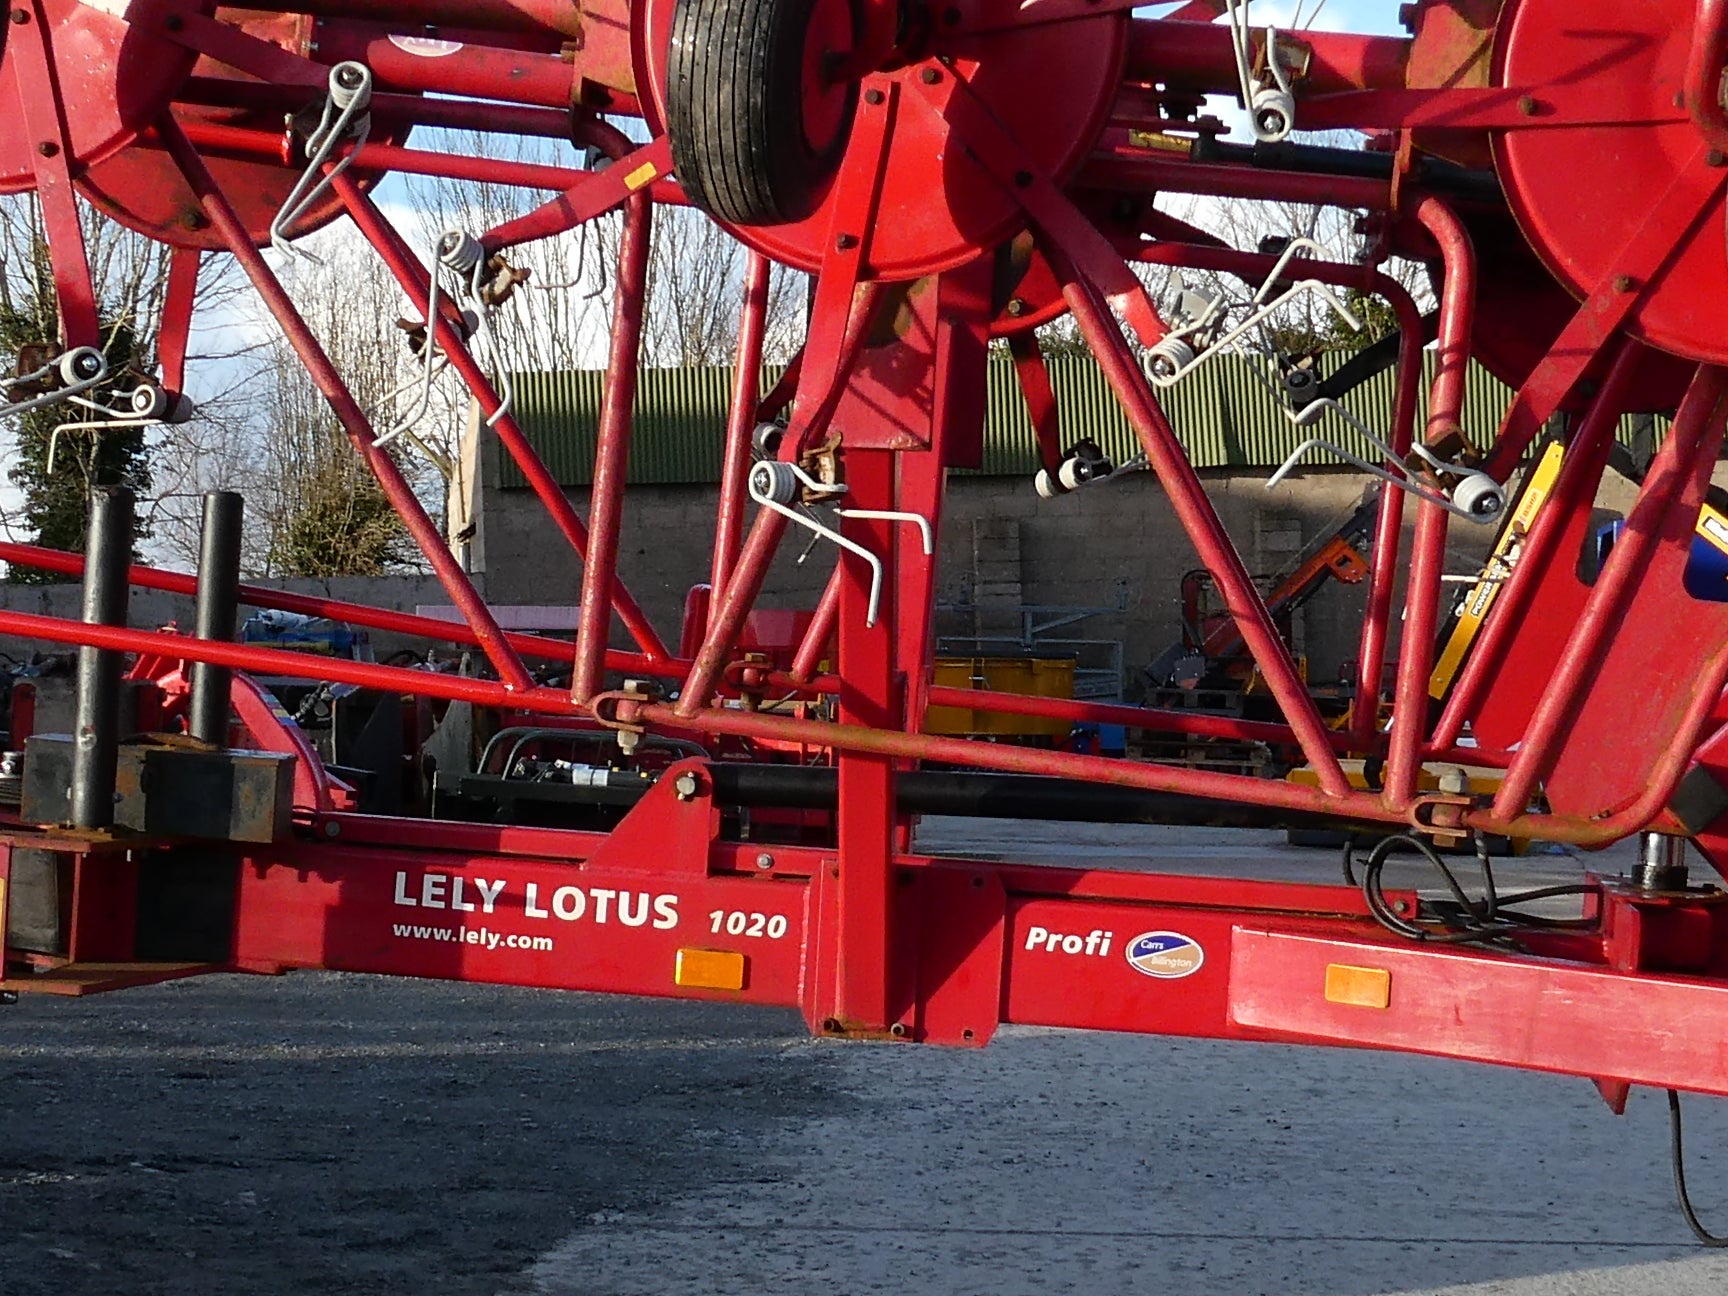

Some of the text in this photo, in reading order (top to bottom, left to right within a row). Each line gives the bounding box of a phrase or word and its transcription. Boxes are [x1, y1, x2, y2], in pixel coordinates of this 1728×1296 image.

[393, 871, 788, 939] LELY LOTUS 1020
[393, 922, 553, 951] www.lely.com
[1025, 926, 1113, 956] Profi
[1140, 939, 1165, 950] Carrs
